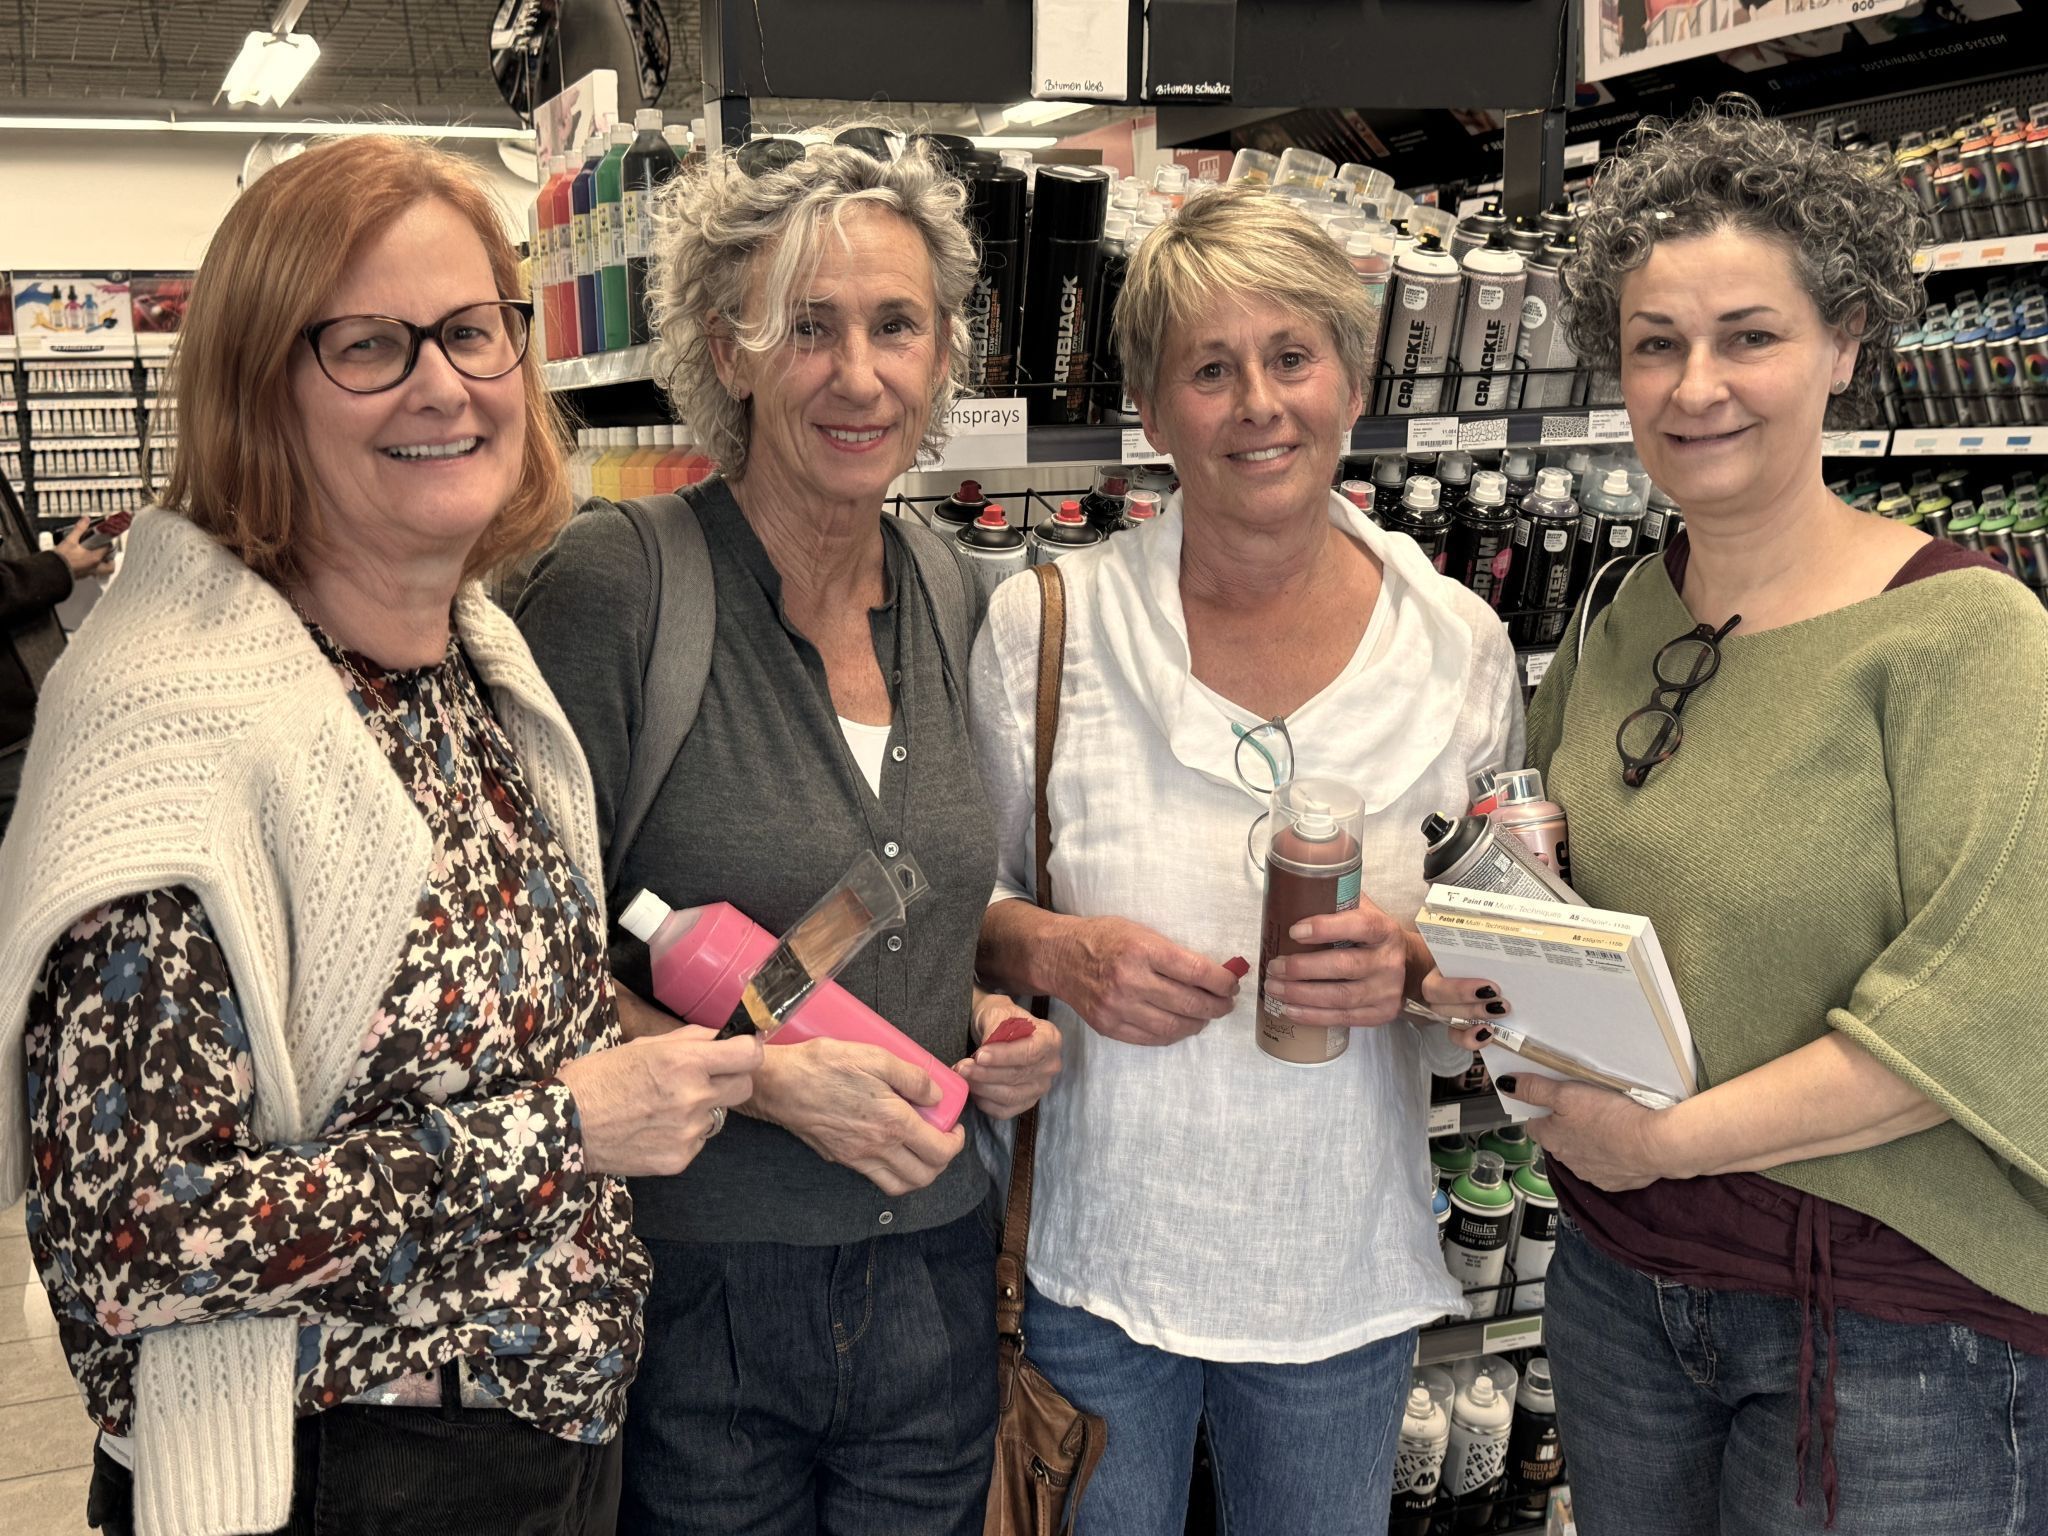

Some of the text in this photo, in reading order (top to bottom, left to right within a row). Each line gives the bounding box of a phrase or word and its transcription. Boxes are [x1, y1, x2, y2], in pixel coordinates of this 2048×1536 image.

[1861, 33, 2008, 72] SUSTAINABLE COLOR SYSTEM
[1044, 79, 1082, 91] Bitumen
[1195, 82, 1231, 94] schwarz
[1052, 275, 1078, 400] TARBLACK
[1397, 319, 1425, 408] CRACKLE
[1474, 319, 1501, 406] CRACKLE
[1462, 897, 1481, 906] Paint
[1439, 915, 1455, 923] Paint
[1461, 1218, 1499, 1236] Liquitex
[1459, 1234, 1476, 1245] SPRAY
